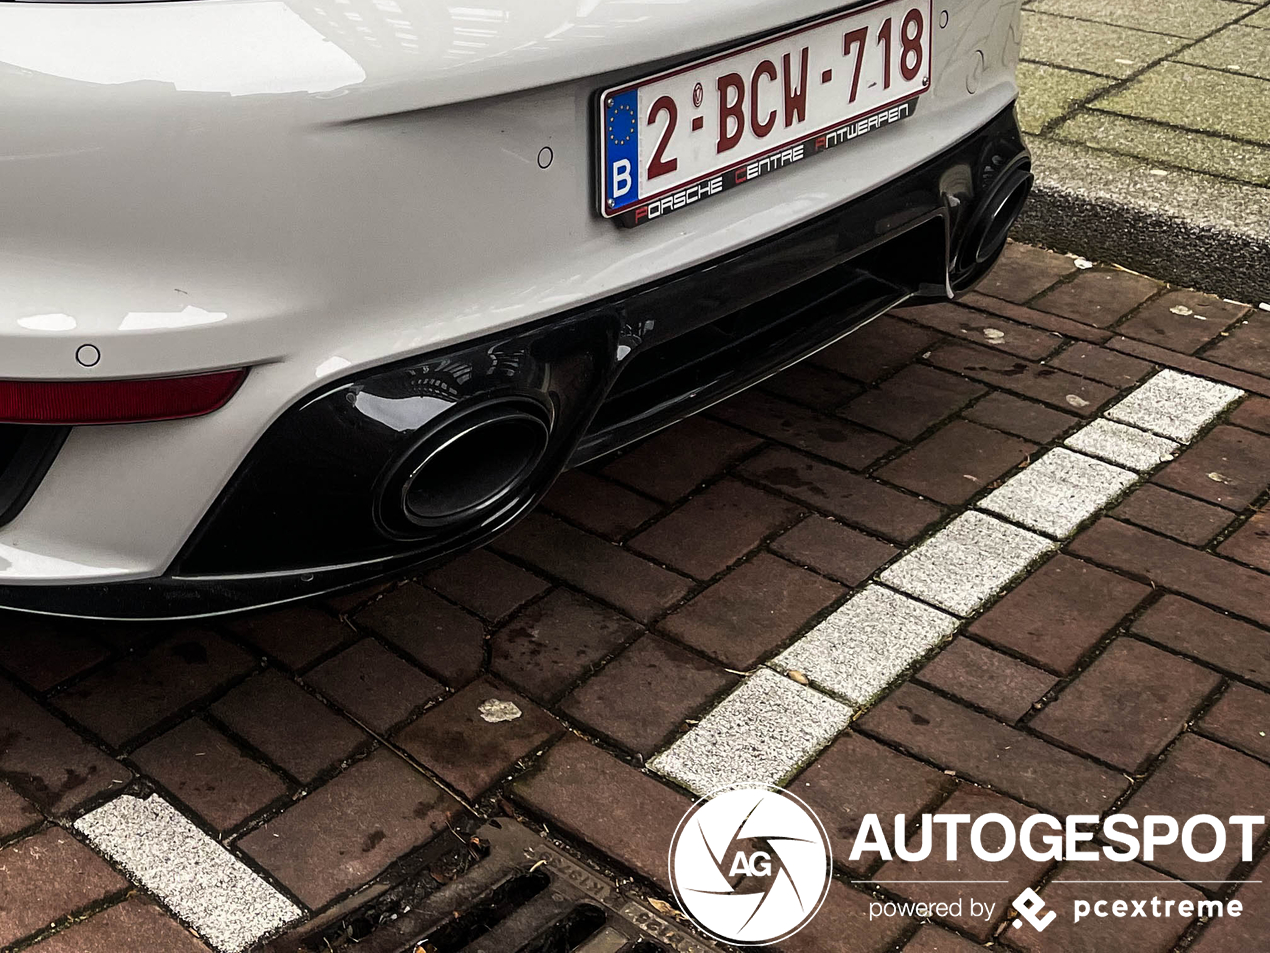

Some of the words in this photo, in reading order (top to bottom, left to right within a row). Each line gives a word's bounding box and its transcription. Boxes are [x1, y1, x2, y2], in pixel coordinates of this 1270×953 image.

[646, 8, 924, 180] 2-BCW-718
[613, 158, 632, 198] B
[635, 176, 723, 224] PORSCHE
[734, 145, 804, 184] CENTRE
[815, 103, 909, 149] ANTWERPEN
